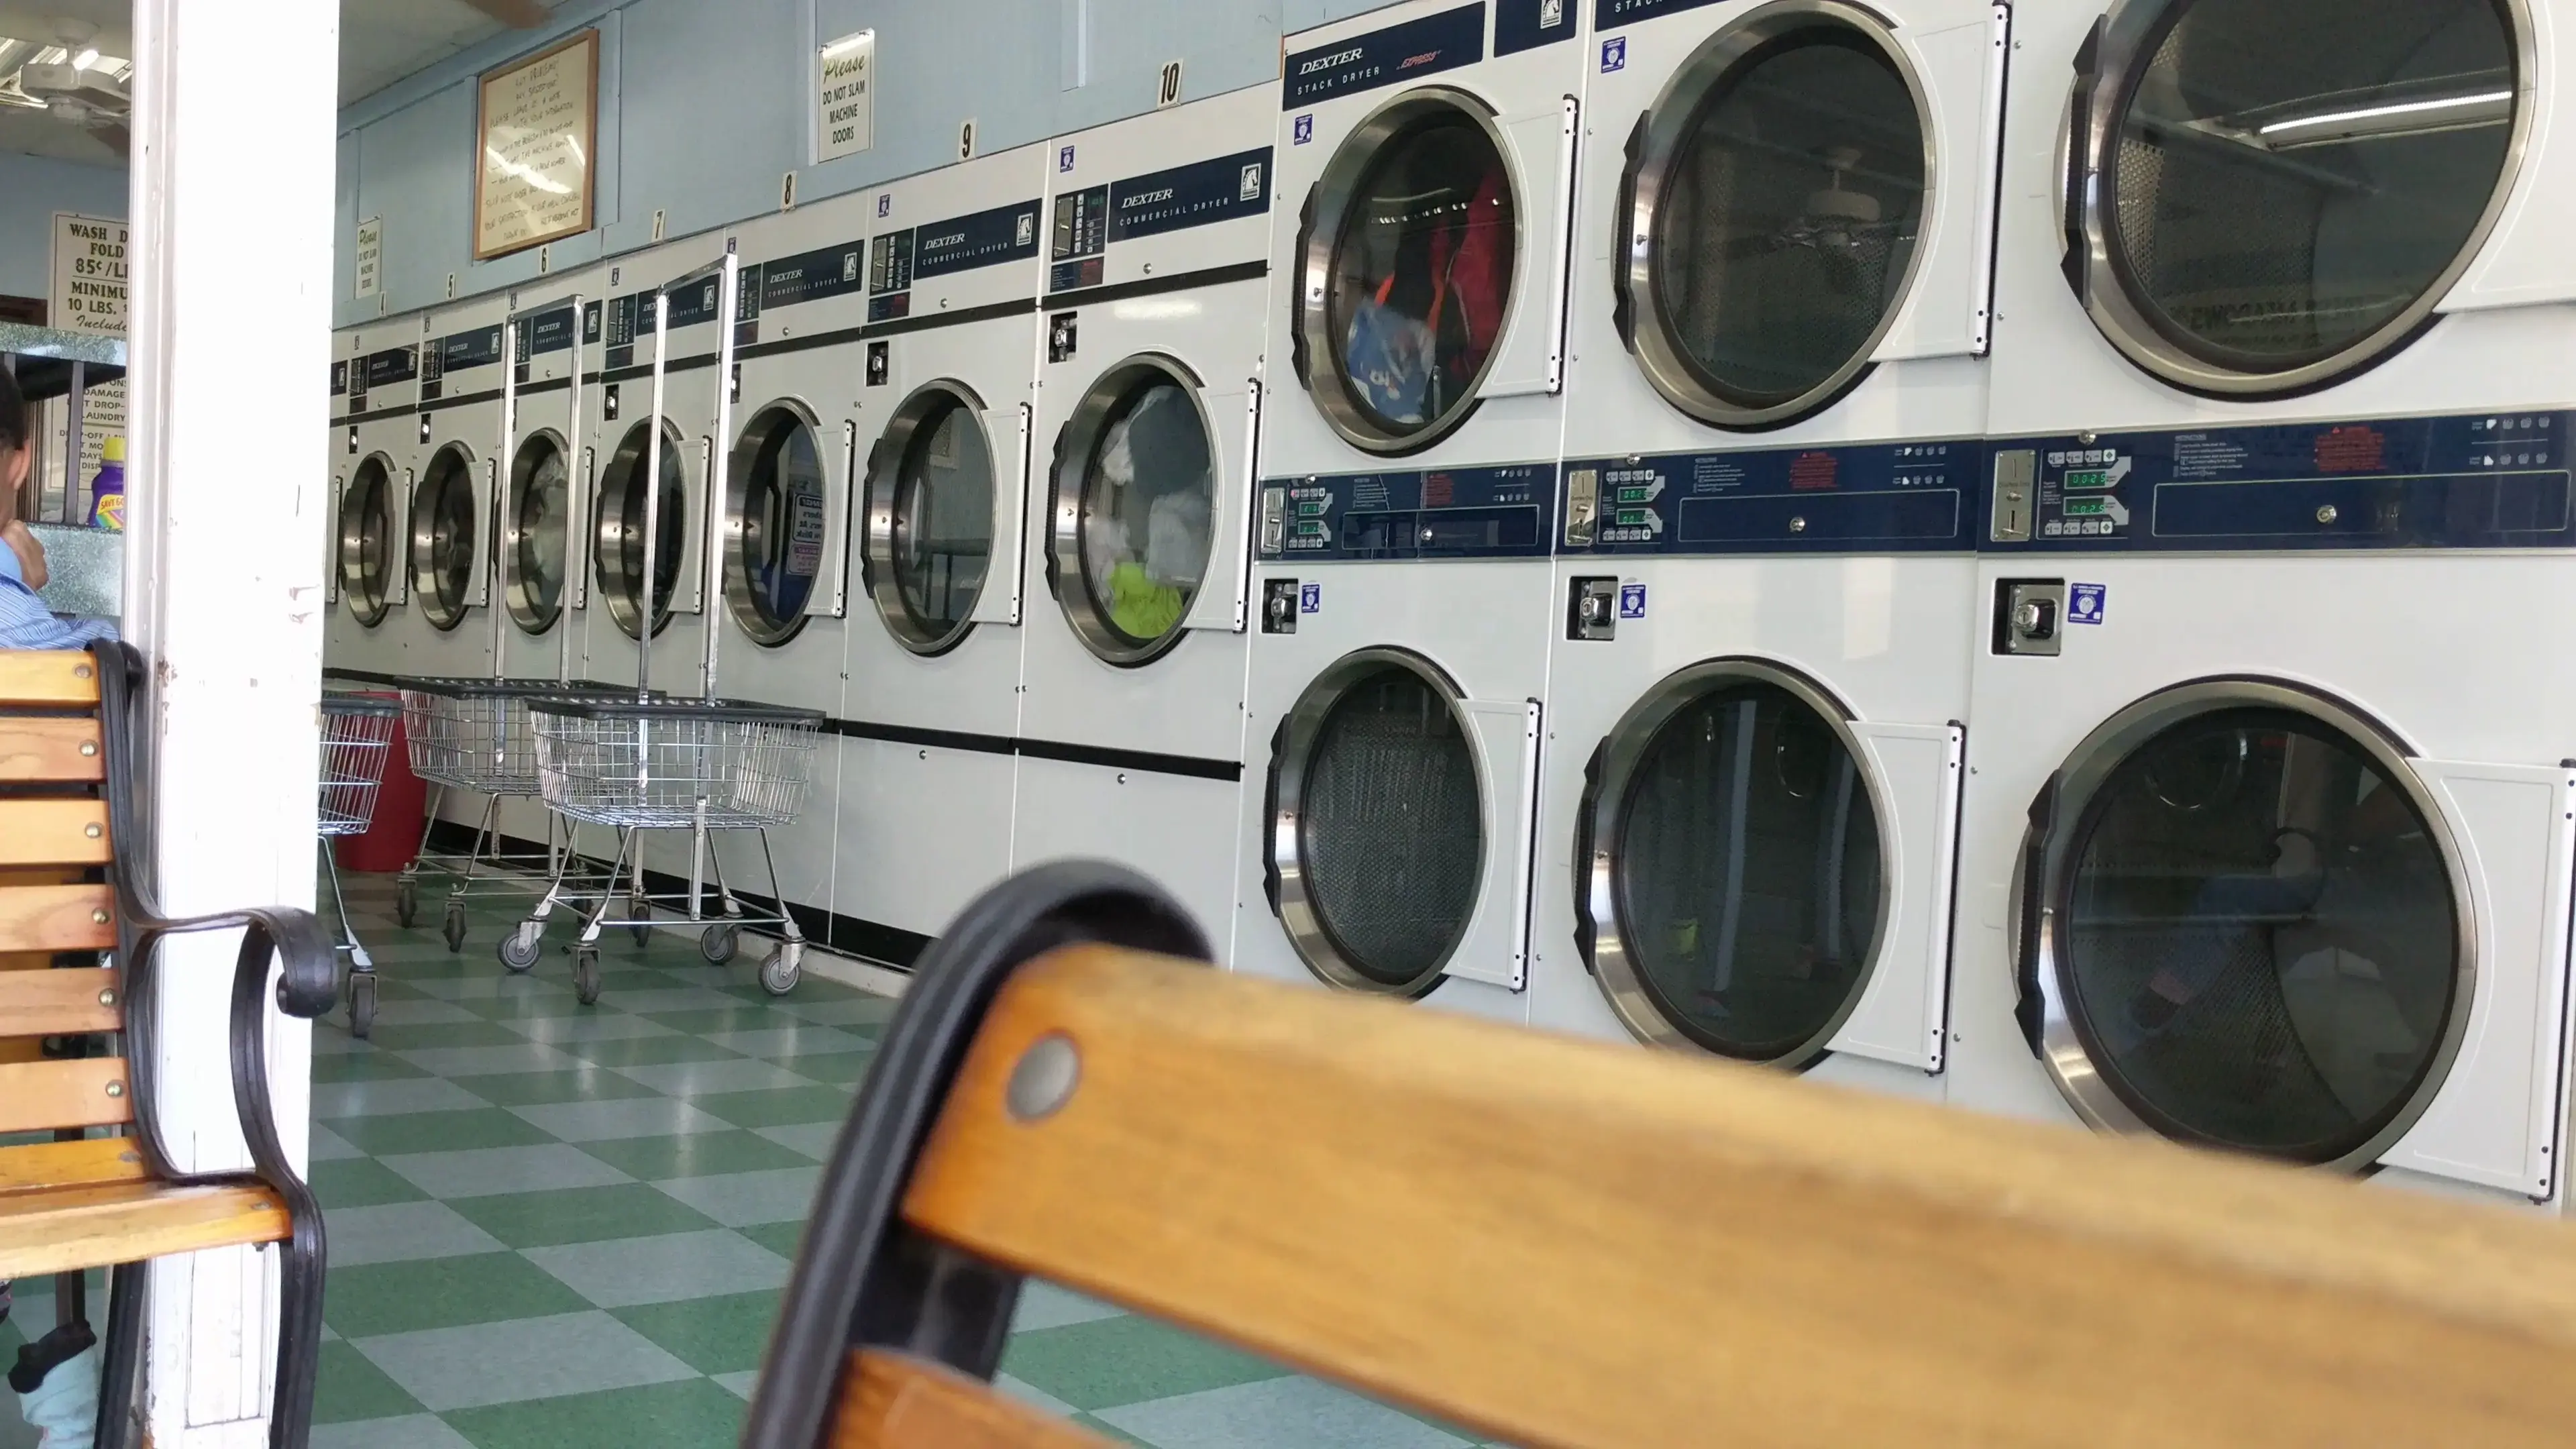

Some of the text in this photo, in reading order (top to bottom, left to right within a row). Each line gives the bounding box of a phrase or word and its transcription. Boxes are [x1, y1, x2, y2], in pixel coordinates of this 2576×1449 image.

[823, 55, 865, 84] Please
[1299, 48, 1362, 75] DEXTER
[823, 80, 865, 105] DO NOT SLAM
[1161, 62, 1179, 103] 10
[1297, 66, 1379, 96] STACK DRYER
[830, 103, 857, 124] MACHINE
[833, 125, 854, 144] DOORS
[963, 123, 971, 158] 9
[785, 174, 792, 205] 8
[1121, 188, 1173, 209] DEXTER
[1120, 197, 1228, 227] COMMERCIAL DRYER
[70, 223, 107, 240] WASH
[656, 211, 663, 239] 7
[91, 242, 124, 258] FOLD
[924, 233, 965, 250] DEXTER
[541, 248, 547, 272] 6
[923, 242, 1008, 266] COMMERCIAL DRYER
[448, 274, 453, 298] 5
[770, 269, 802, 283] DEXTER
[68, 298, 82, 311] 10
[89, 301, 117, 315] LBS.
